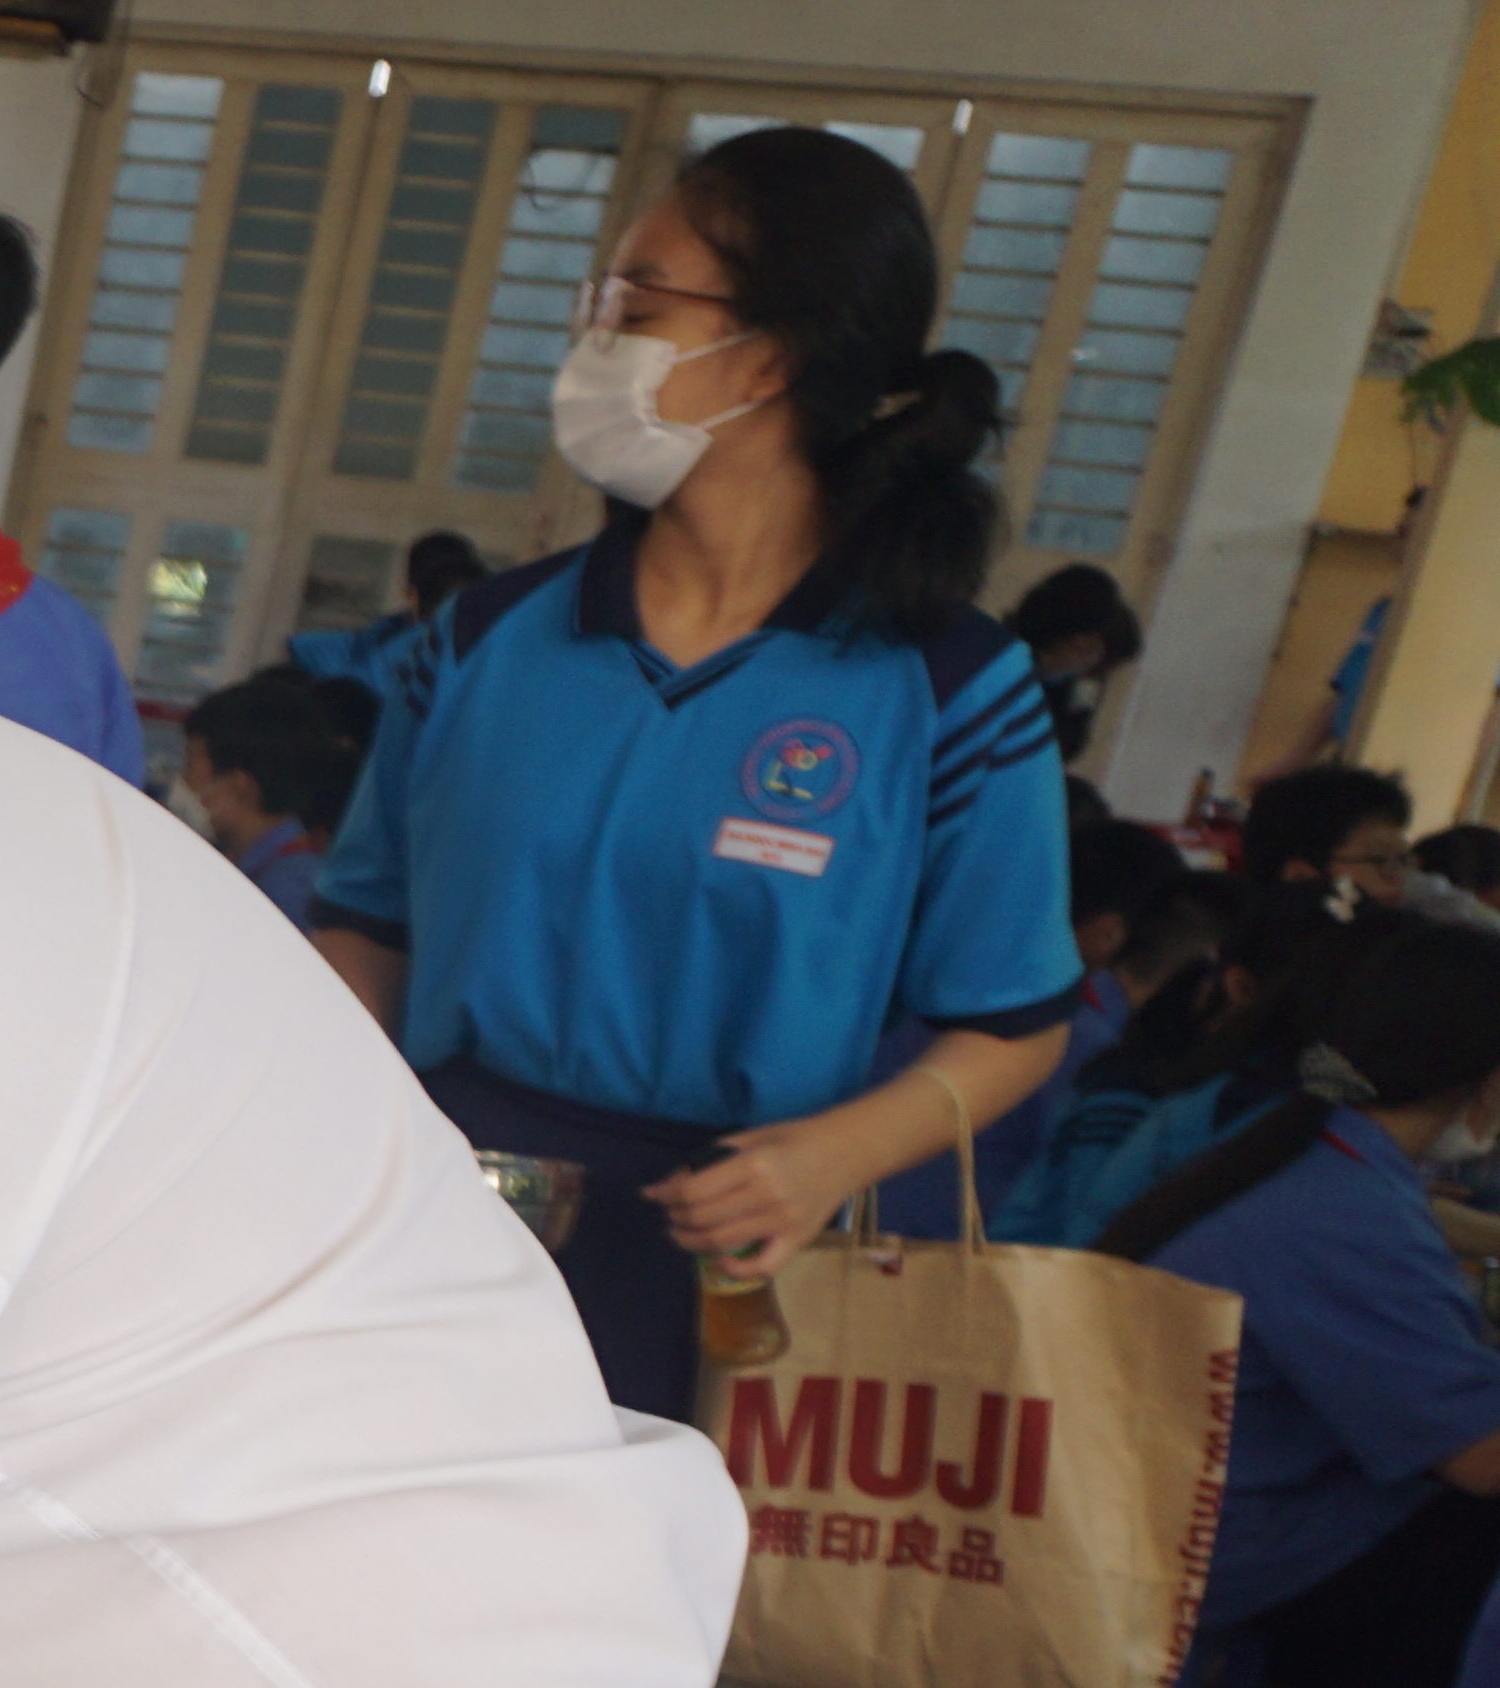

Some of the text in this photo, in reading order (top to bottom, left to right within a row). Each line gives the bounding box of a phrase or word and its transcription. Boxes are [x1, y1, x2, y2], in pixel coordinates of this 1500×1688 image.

[727, 1375, 1054, 1519] MUJI
[748, 1504, 1004, 1587] 無印良品
